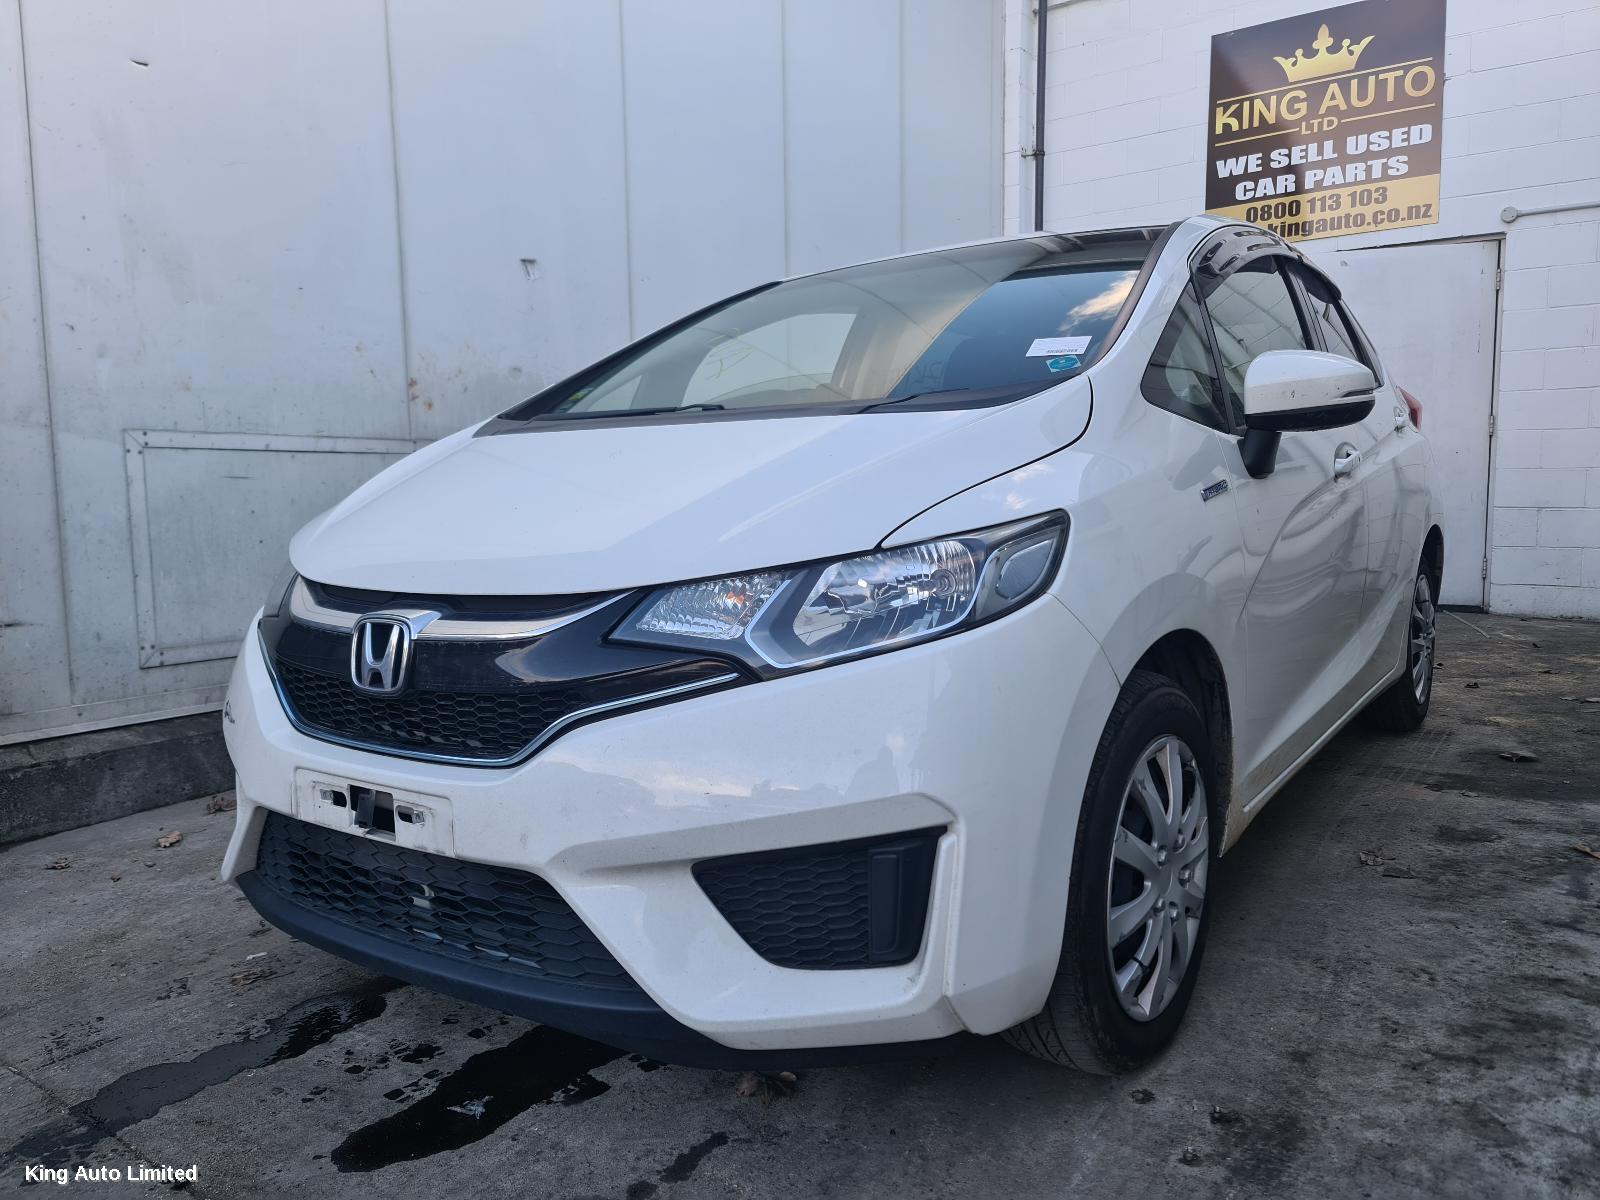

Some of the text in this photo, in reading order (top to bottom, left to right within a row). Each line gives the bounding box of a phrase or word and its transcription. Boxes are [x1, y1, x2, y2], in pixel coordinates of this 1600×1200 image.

[1215, 65, 1436, 135] KING AUTO
[1301, 116, 1339, 136] LTD
[1215, 123, 1433, 179] WE SELL USED
[1235, 155, 1409, 201] CAR PARTS
[1245, 186, 1388, 224] 0800 113 103
